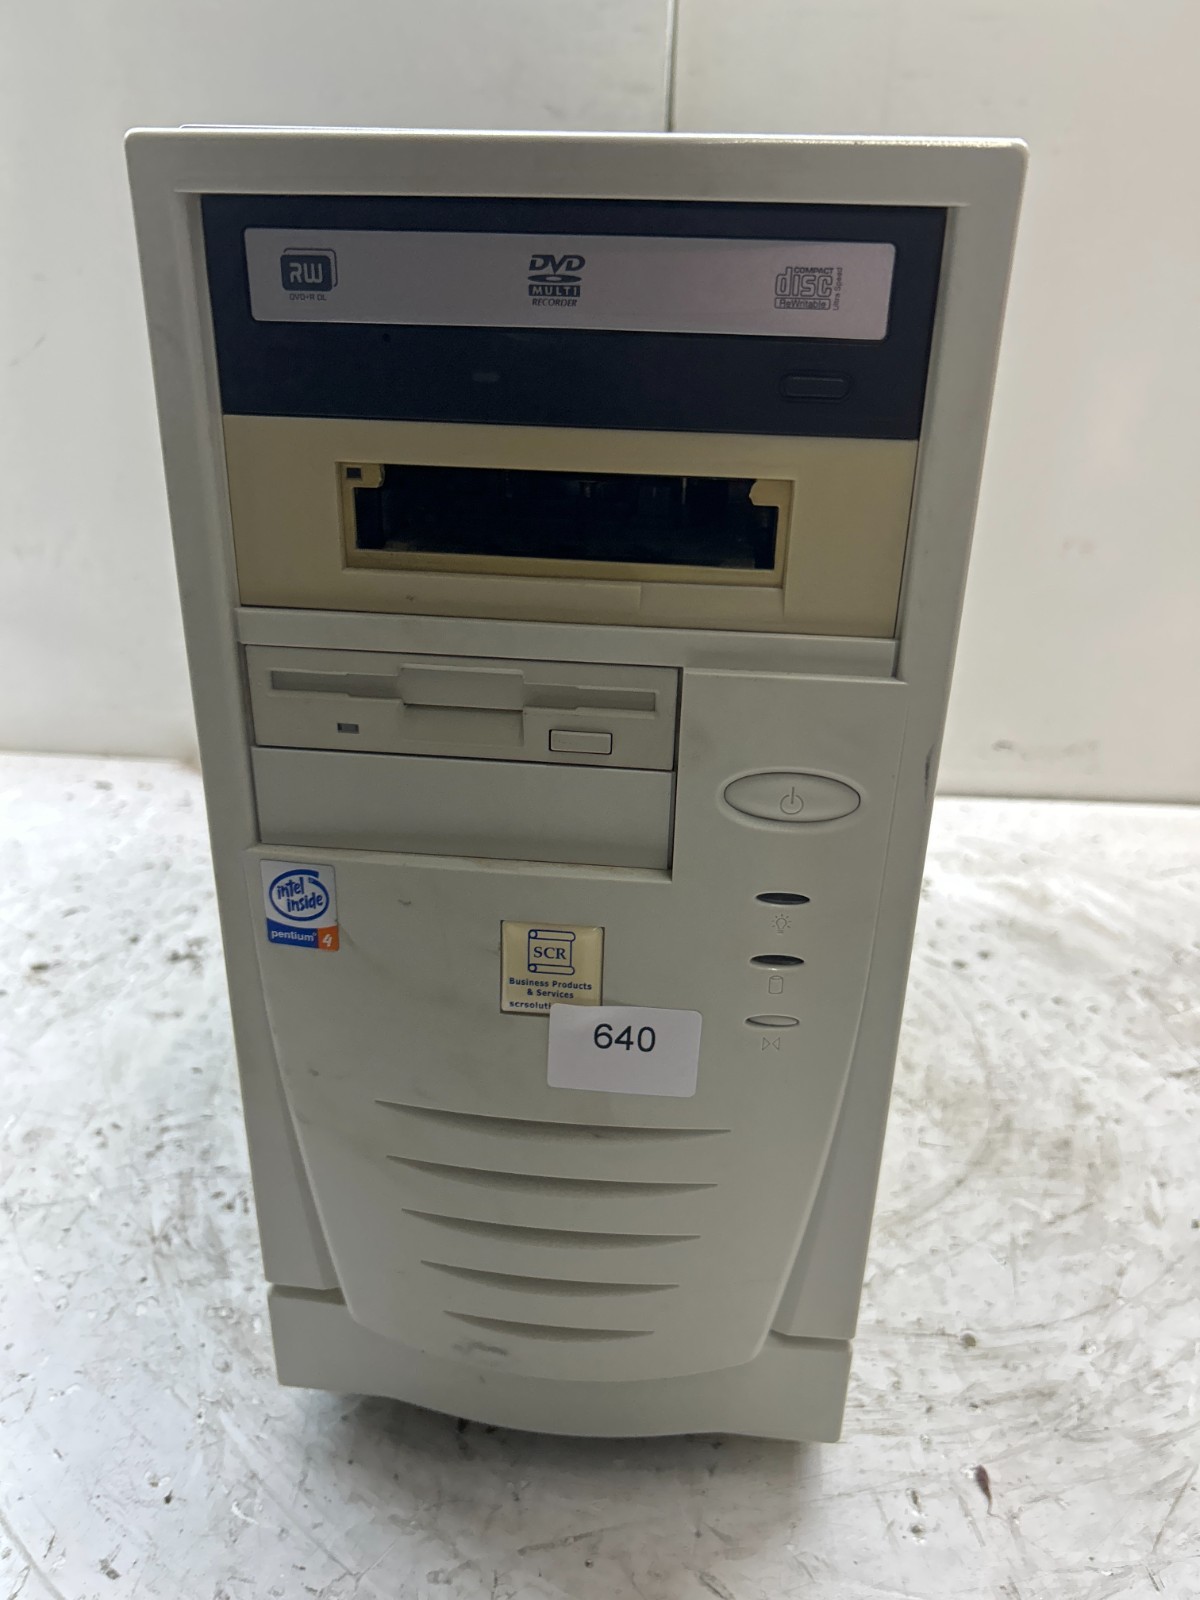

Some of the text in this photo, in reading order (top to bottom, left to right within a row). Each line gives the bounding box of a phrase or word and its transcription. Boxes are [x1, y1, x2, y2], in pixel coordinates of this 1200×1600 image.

[528, 254, 586, 275] DVD
[793, 266, 834, 275] COMPACT
[289, 262, 323, 284] RW
[774, 266, 833, 297] disc
[531, 285, 578, 296] MULTI
[832, 267, 844, 311] Ultra Speed
[532, 298, 578, 307] RECORDER
[779, 299, 827, 310] ReWritable
[277, 876, 305, 900] intel
[286, 892, 324, 913] inside
[322, 933, 334, 948] 4
[533, 946, 567, 960] SCR
[508, 977, 593, 991] Business Products
[527, 988, 575, 999] & Services
[509, 1000, 552, 1011] scrsoluti
[593, 1023, 657, 1053] 640
